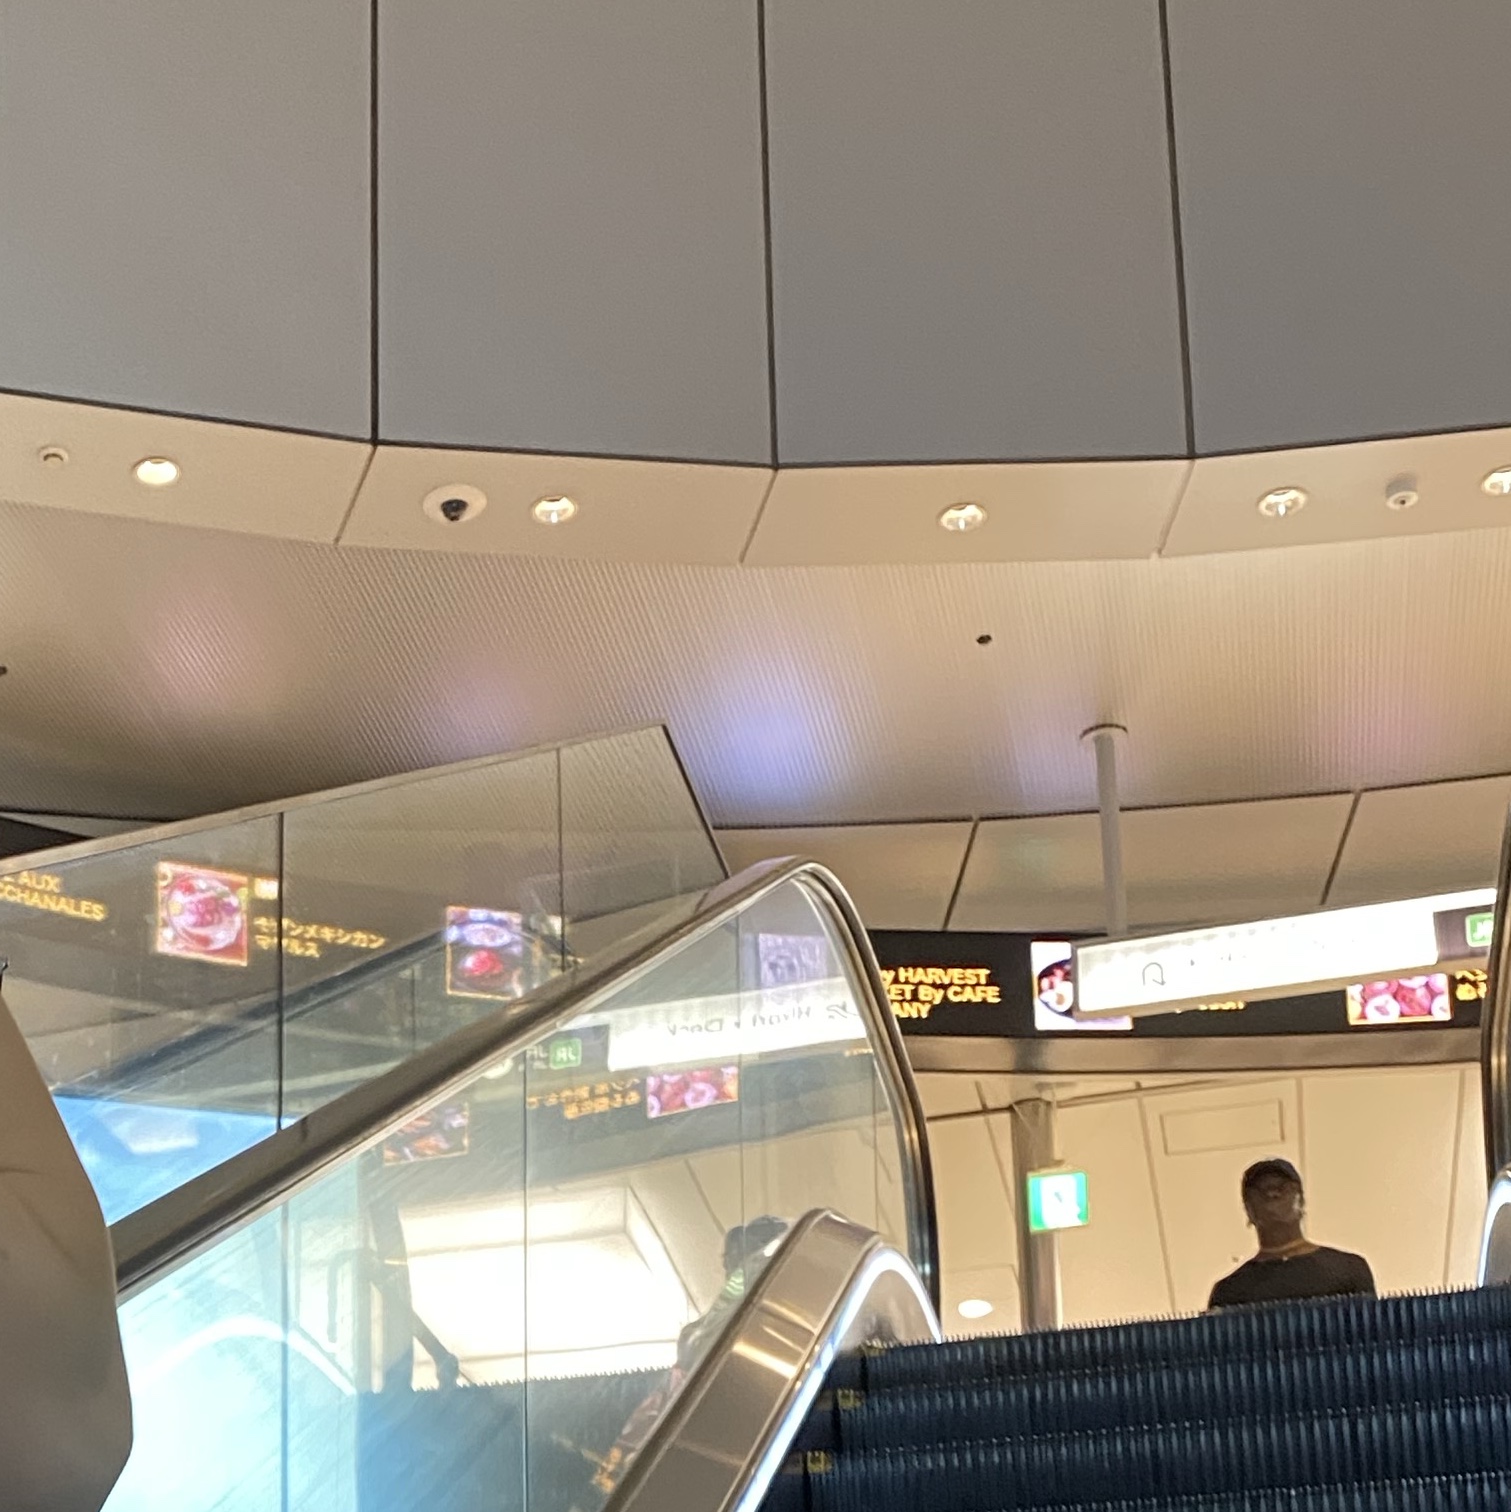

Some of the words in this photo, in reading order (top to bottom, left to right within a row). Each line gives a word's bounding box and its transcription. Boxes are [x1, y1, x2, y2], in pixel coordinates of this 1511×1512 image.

[898, 967, 991, 985] HARVEST
[886, 984, 916, 1001] ET
[918, 985, 944, 1005] By
[947, 986, 1002, 1003] CAFE
